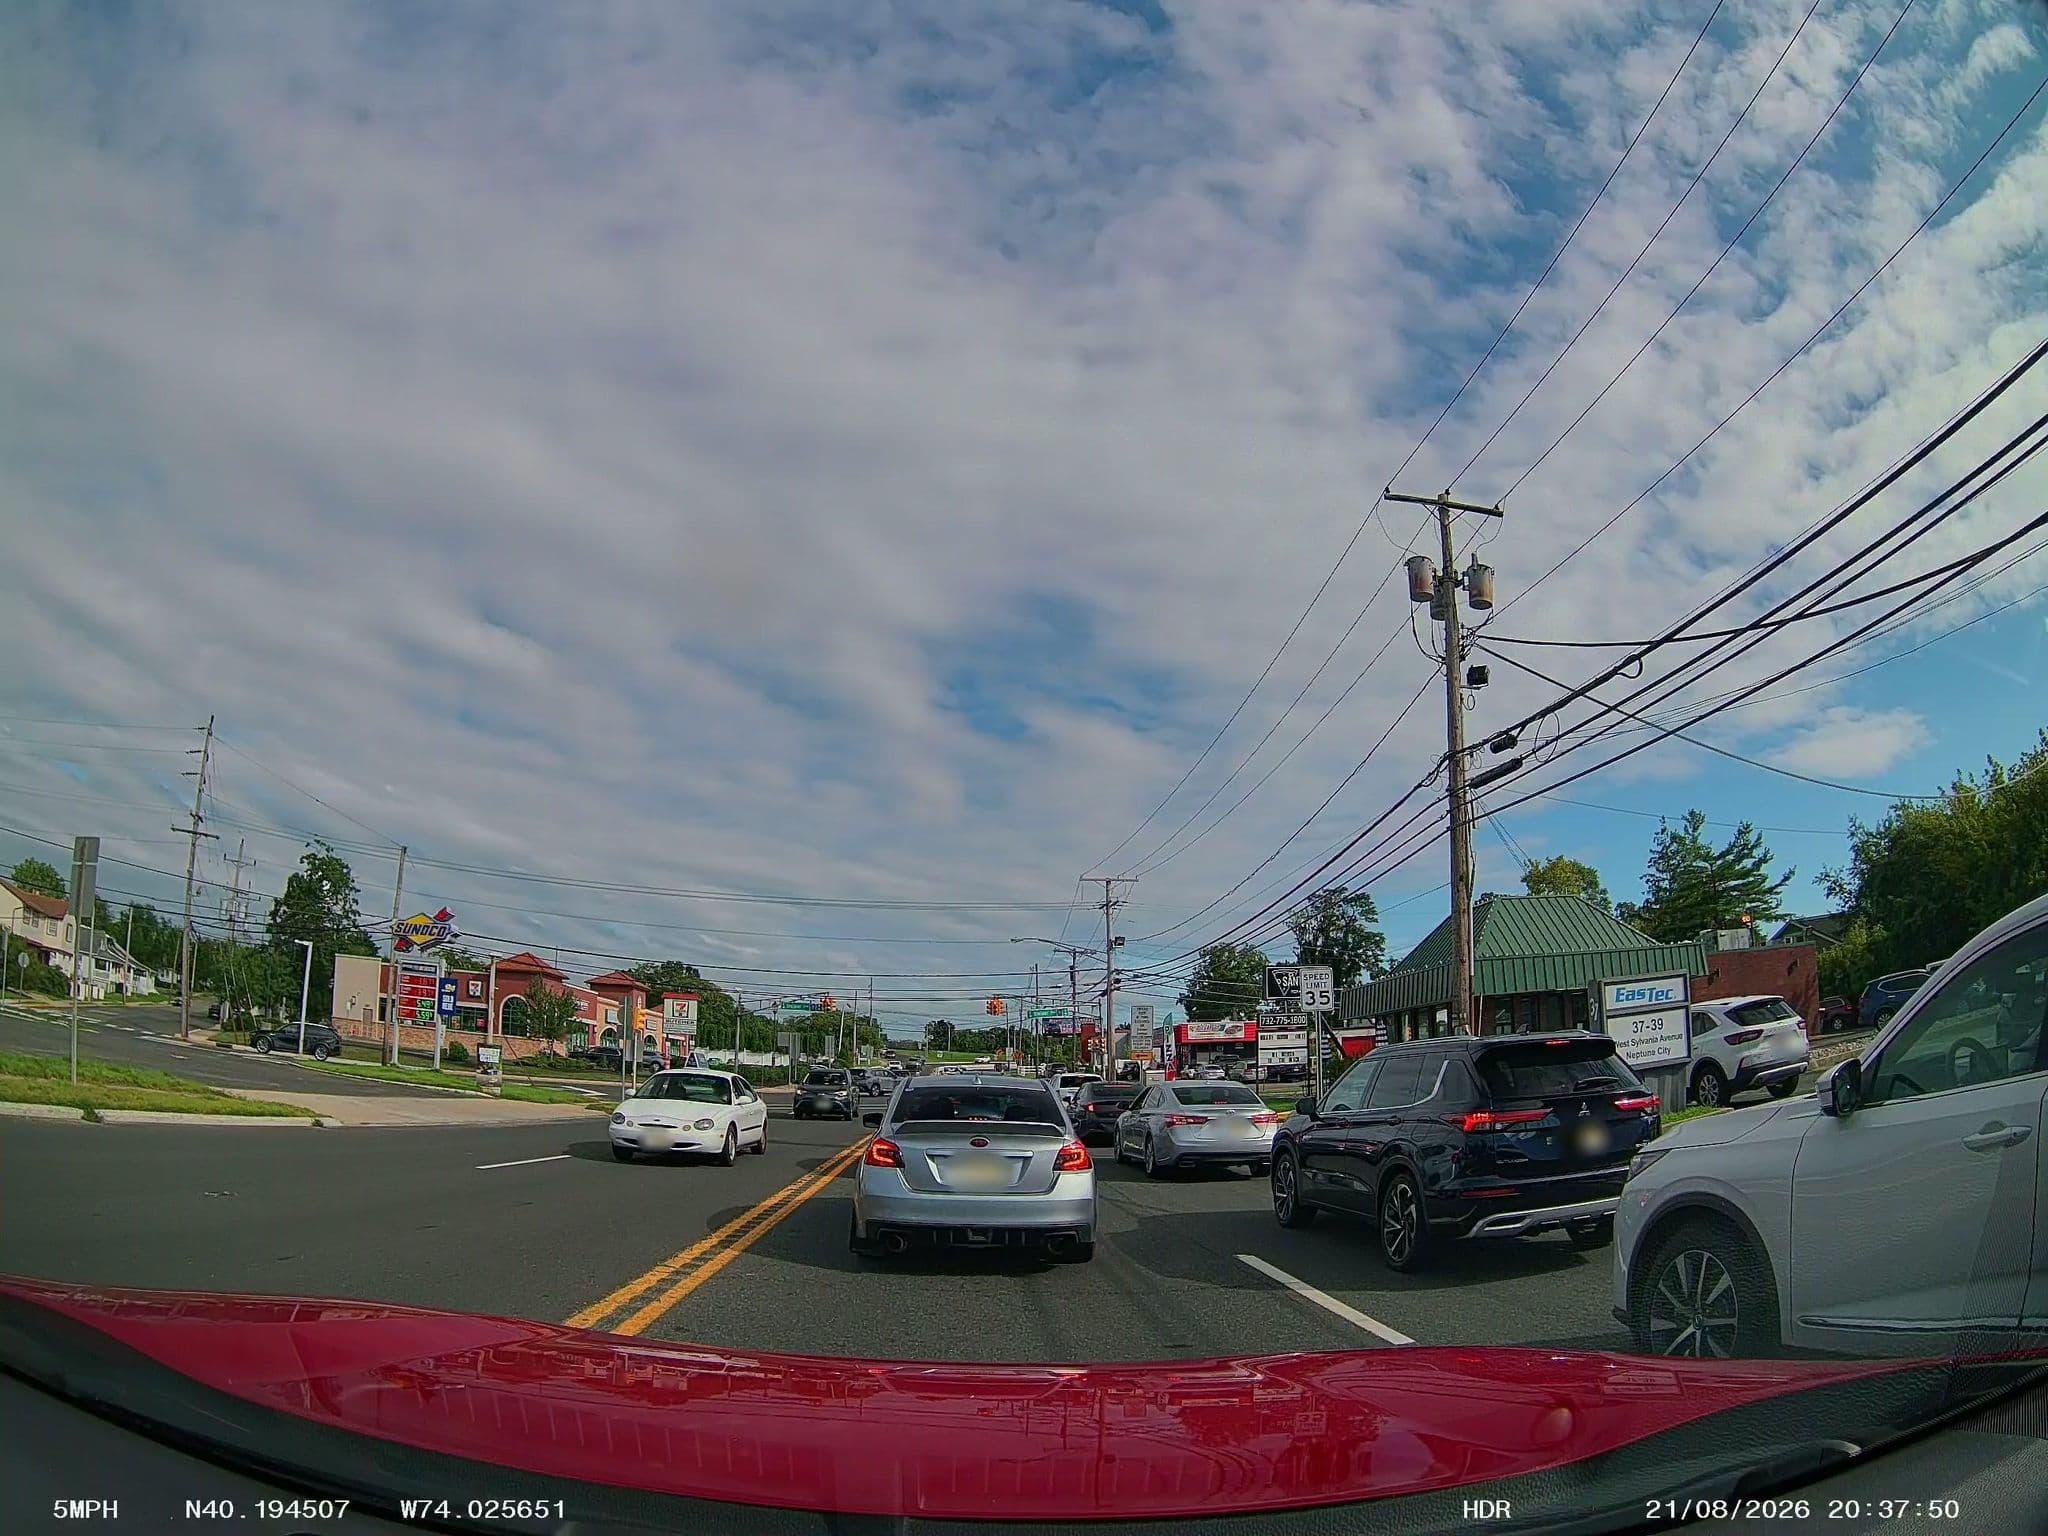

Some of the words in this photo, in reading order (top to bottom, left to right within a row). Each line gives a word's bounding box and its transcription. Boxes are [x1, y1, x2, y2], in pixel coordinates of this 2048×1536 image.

[395, 922, 447, 937] SUNOCO
[1303, 973, 1329, 981] SPEED
[1306, 981, 1328, 989] LIMIT
[1305, 990, 1330, 1006] 35
[1615, 987, 1673, 1002] EasTec
[1632, 1018, 1664, 1034] 37-39
[1631, 1035, 1659, 1048] Sylvania
[1659, 1032, 1684, 1042] Avenue
[1165, 1027, 1175, 1070] PIZZA
[1626, 1049, 1656, 1060] Neptune
[1657, 1046, 1672, 1056] City
